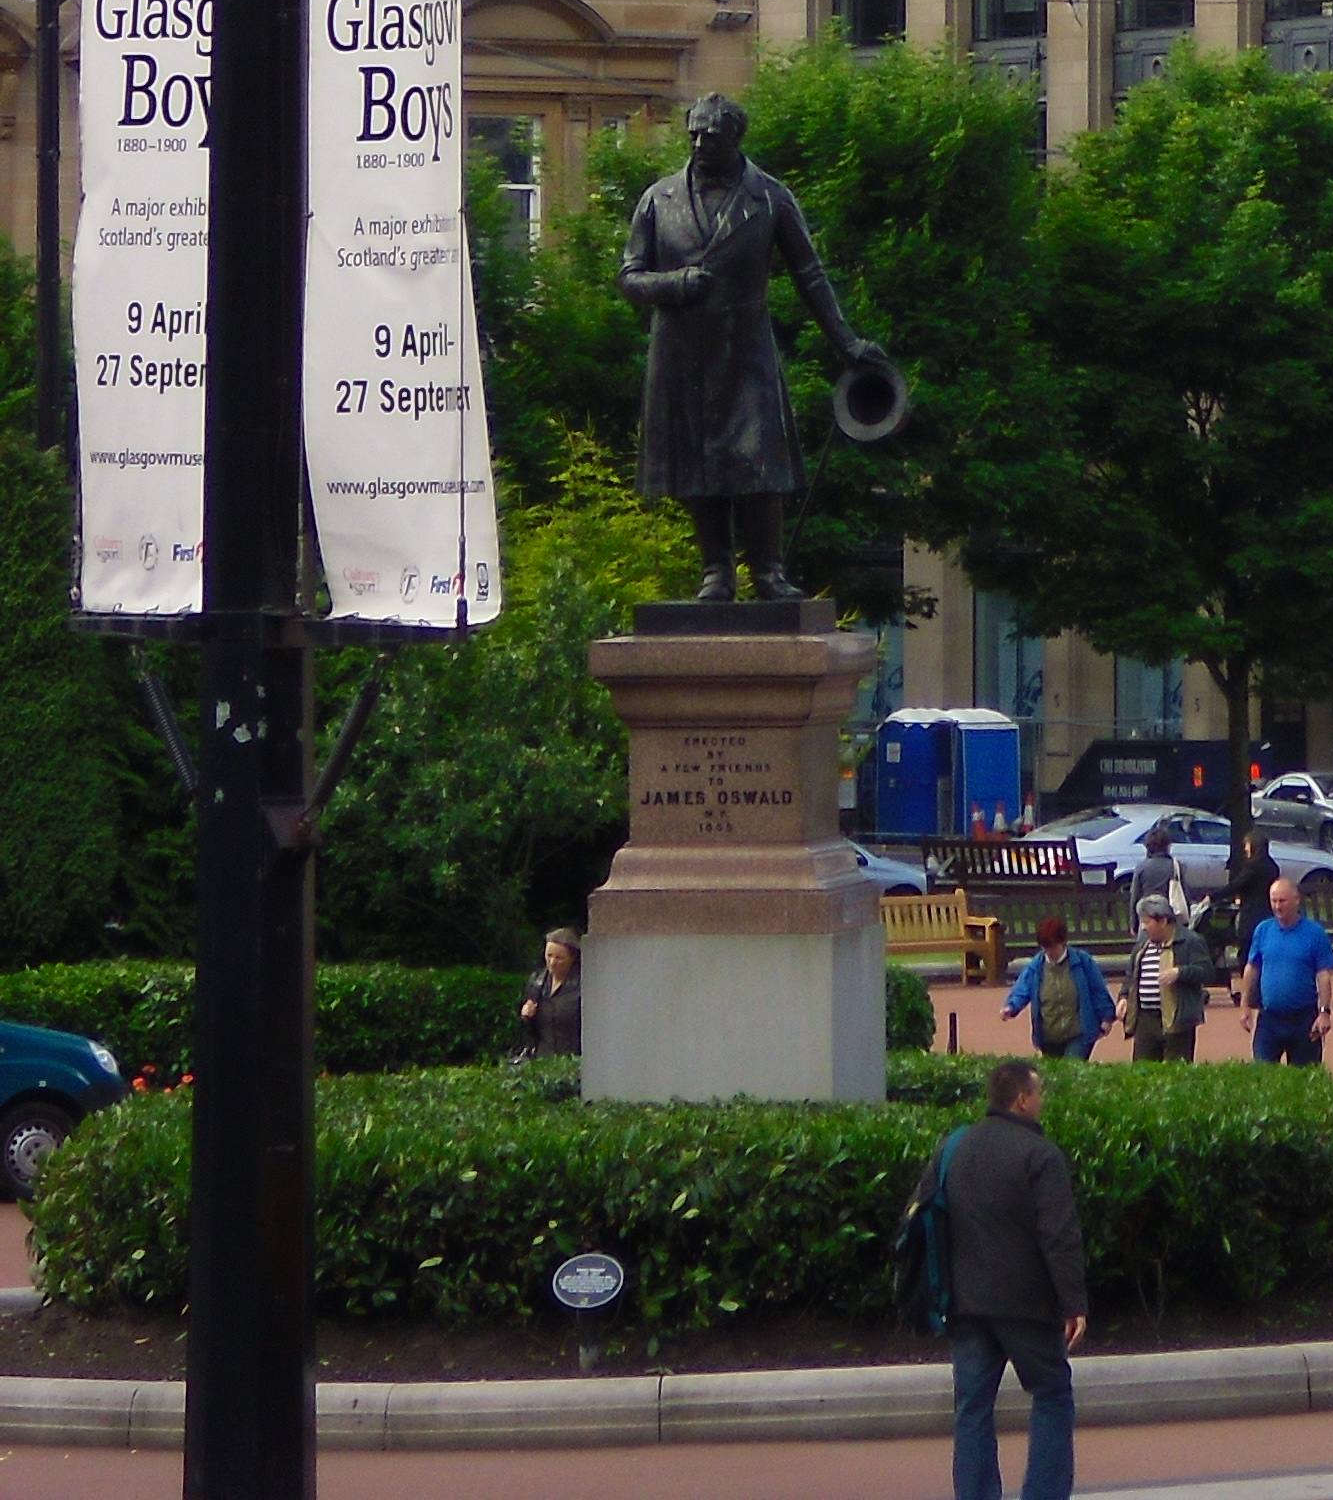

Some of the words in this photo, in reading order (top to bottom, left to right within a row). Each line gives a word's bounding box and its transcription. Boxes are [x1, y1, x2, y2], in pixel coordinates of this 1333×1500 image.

[356, 67, 453, 161] Boys
[111, 198, 121, 216] A
[125, 198, 165, 221] major
[99, 227, 162, 246] Scotland's
[353, 216, 364, 235] A
[369, 215, 407, 240] major
[337, 246, 406, 268] Scotland's
[127, 302, 142, 334] 9
[375, 324, 391, 358] 9
[401, 322, 454, 366] April-
[96, 355, 121, 387] 27
[336, 380, 368, 414] 27
[640, 790, 705, 806] JAMES
[718, 790, 793, 806] OSWALD
